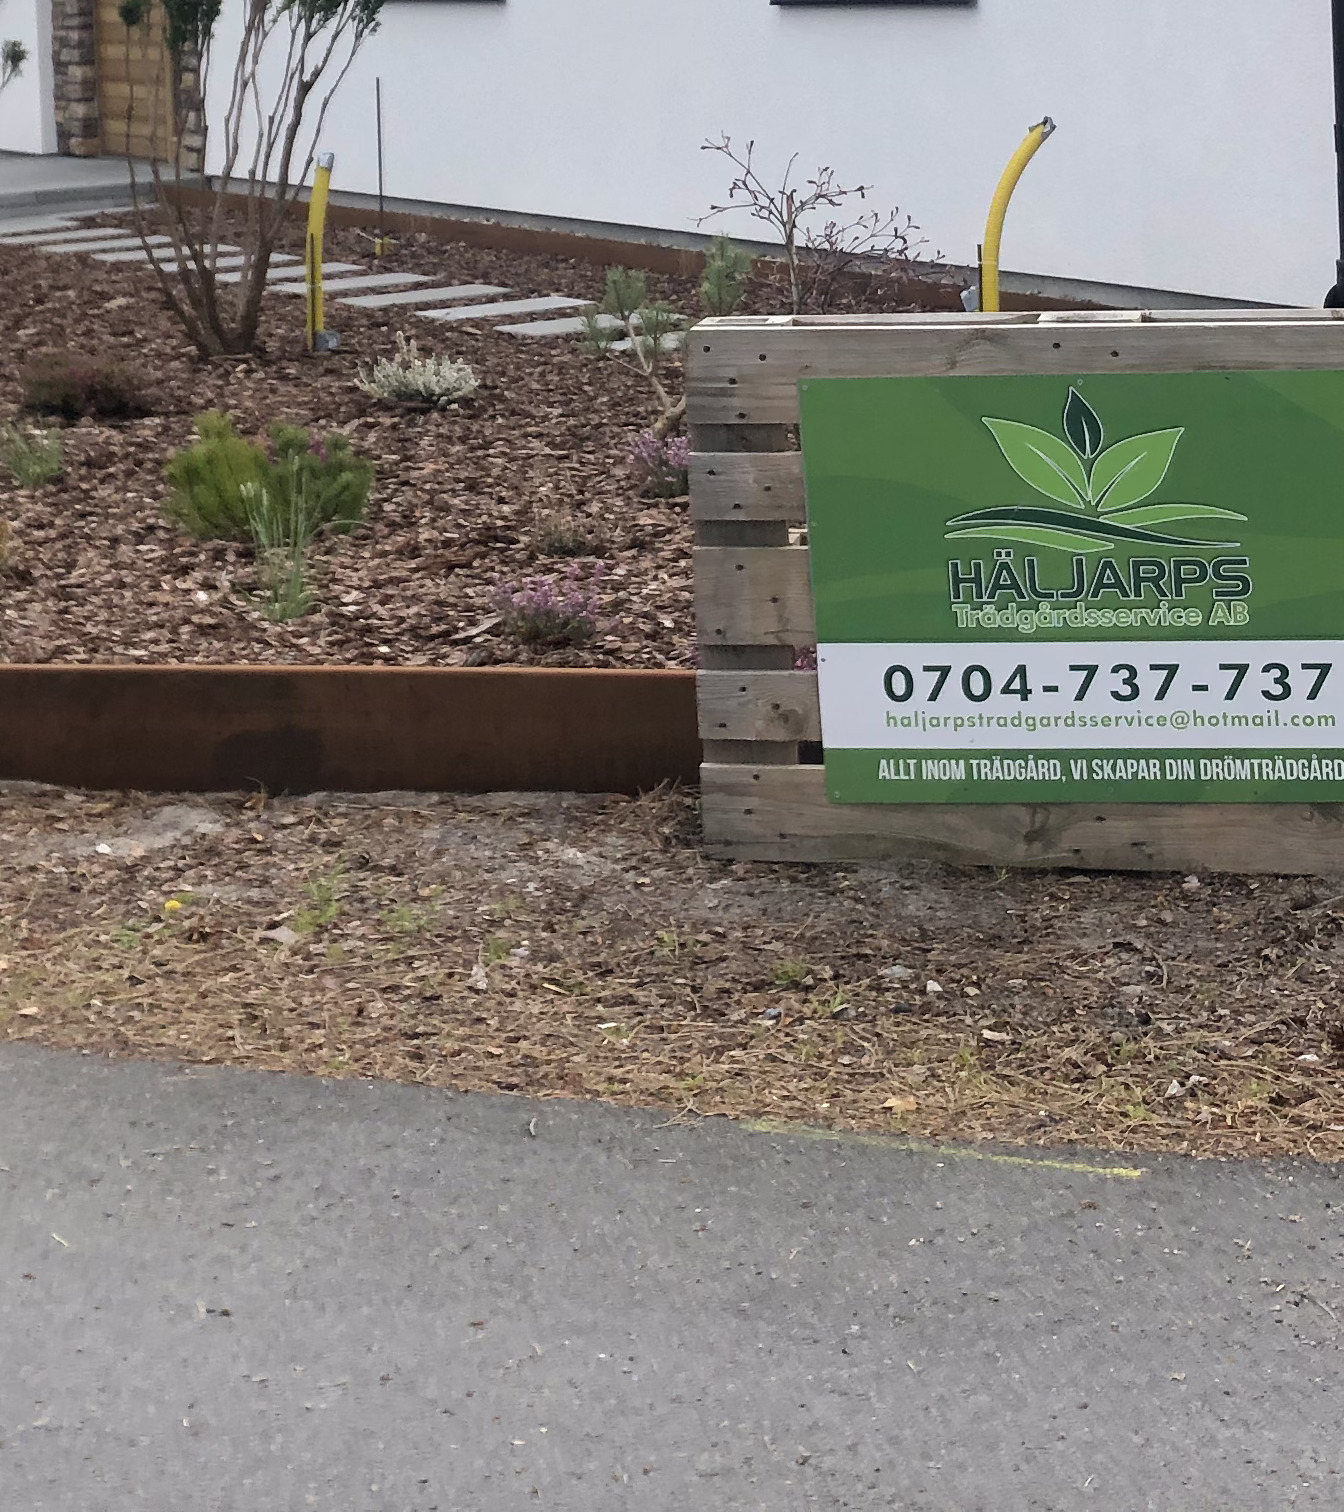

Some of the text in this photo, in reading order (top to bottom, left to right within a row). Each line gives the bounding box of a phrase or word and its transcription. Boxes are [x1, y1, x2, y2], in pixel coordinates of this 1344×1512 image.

[949, 549, 1253, 601] HÄLJARPS
[952, 601, 1250, 634] Trädgårdsservice AB
[883, 663, 1333, 703] 0704-737-737
[886, 710, 1336, 732] haljarpstradgardsservice@hotmail.com
[878, 758, 917, 780] ALLT
[921, 759, 966, 780] INOM
[969, 755, 1066, 782] TRÄDGÅRD,
[1069, 759, 1088, 780] VI
[1092, 759, 1161, 780] SKAPAR
[1165, 759, 1195, 780] DIN
